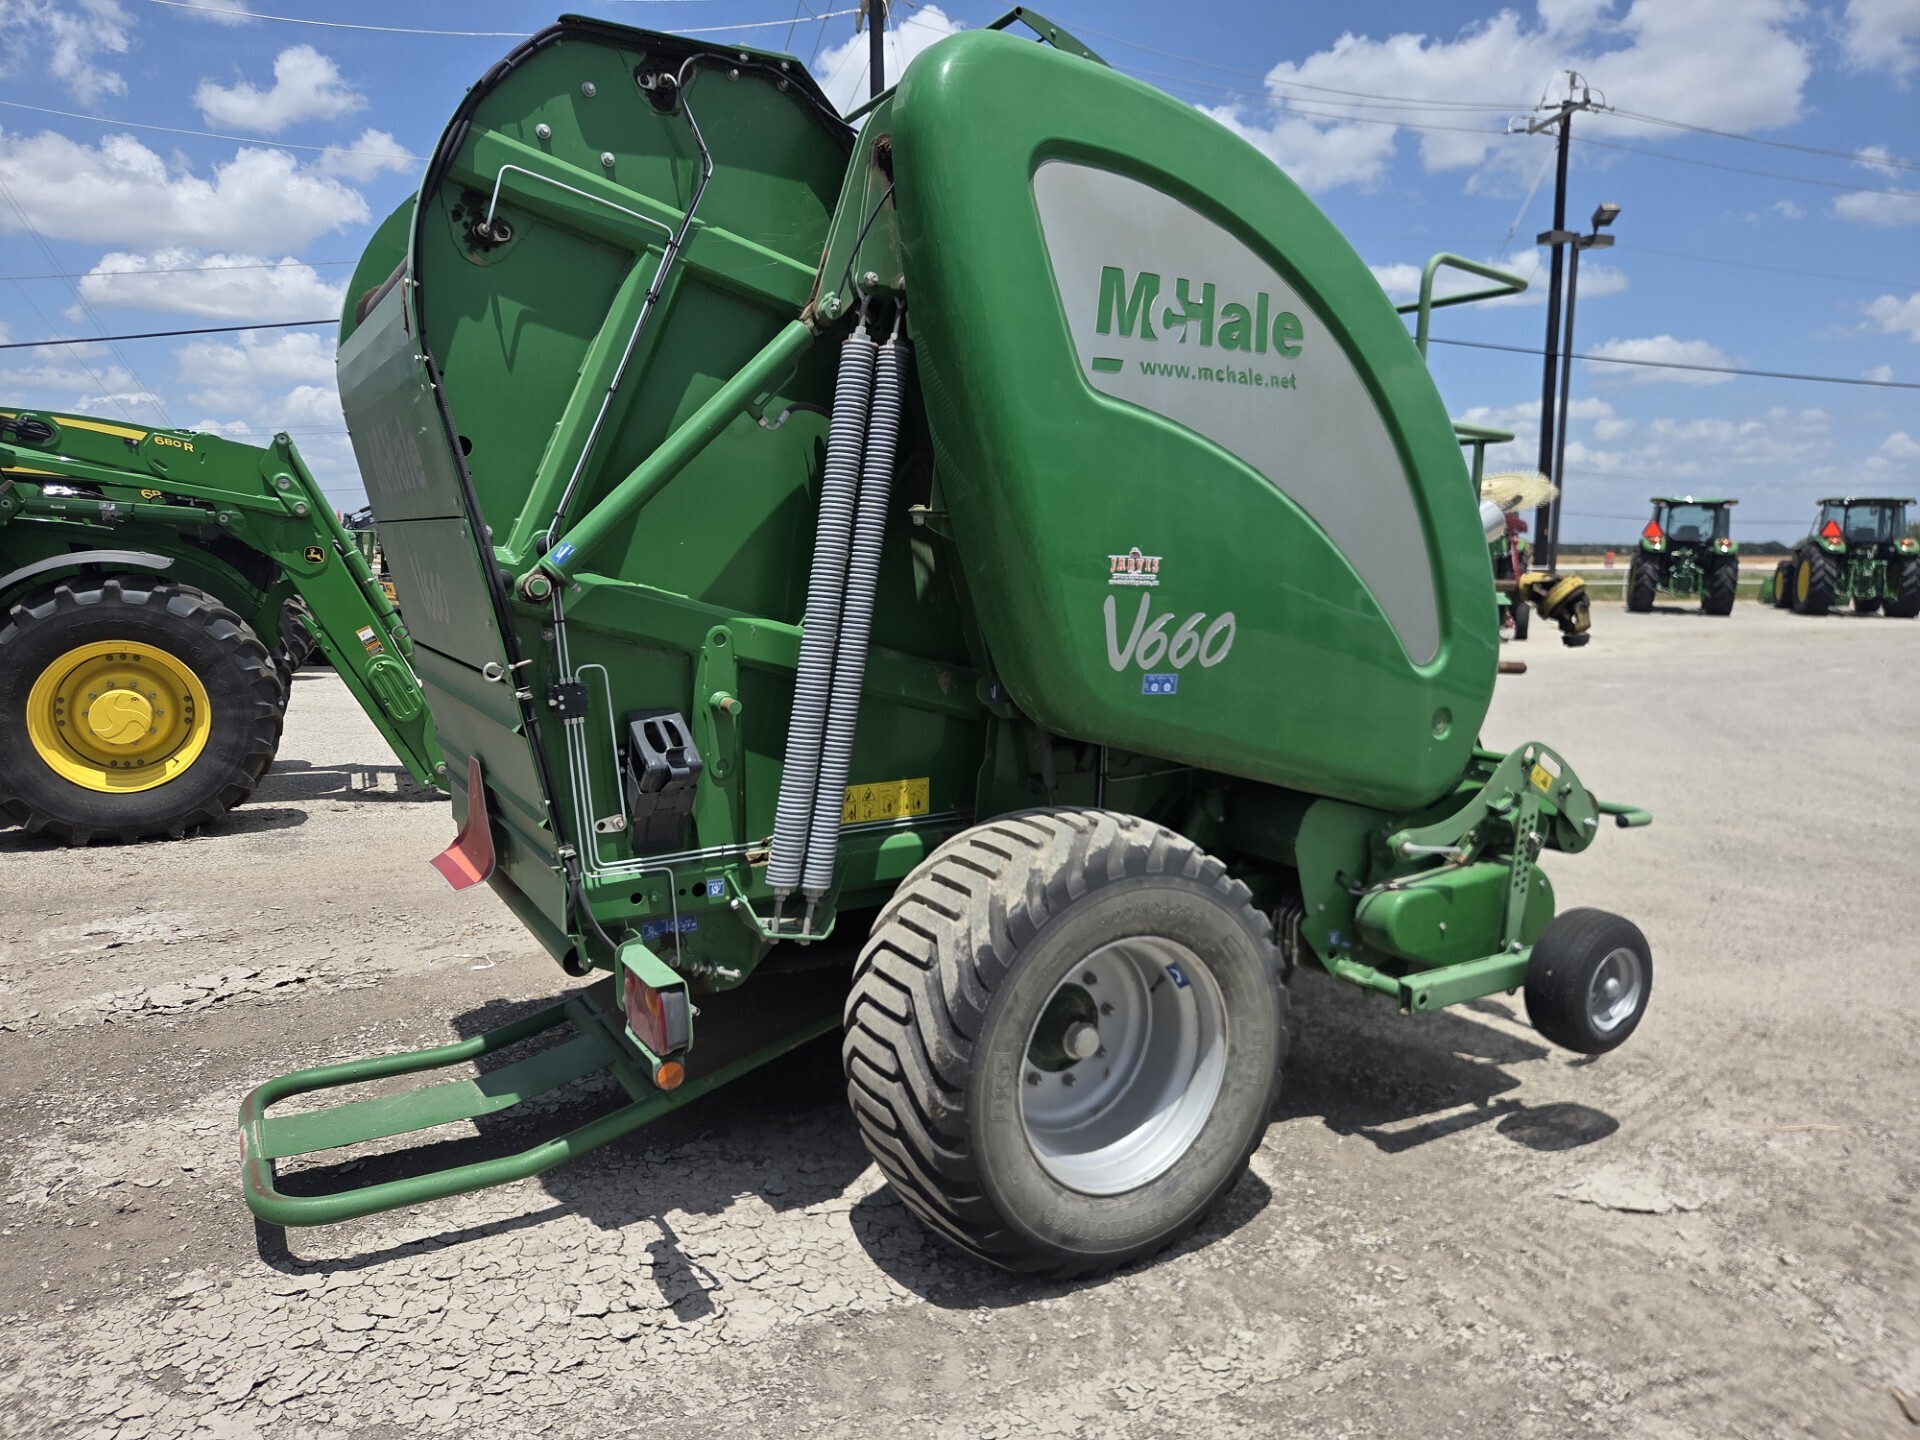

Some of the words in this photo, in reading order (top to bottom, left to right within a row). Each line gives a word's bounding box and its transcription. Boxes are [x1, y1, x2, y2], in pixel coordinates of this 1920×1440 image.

[1095, 265, 1305, 360] McHale
[1140, 361, 1297, 390] www.mchale.net
[1109, 557, 1160, 574] JARVIS
[1103, 591, 1237, 672] V660
